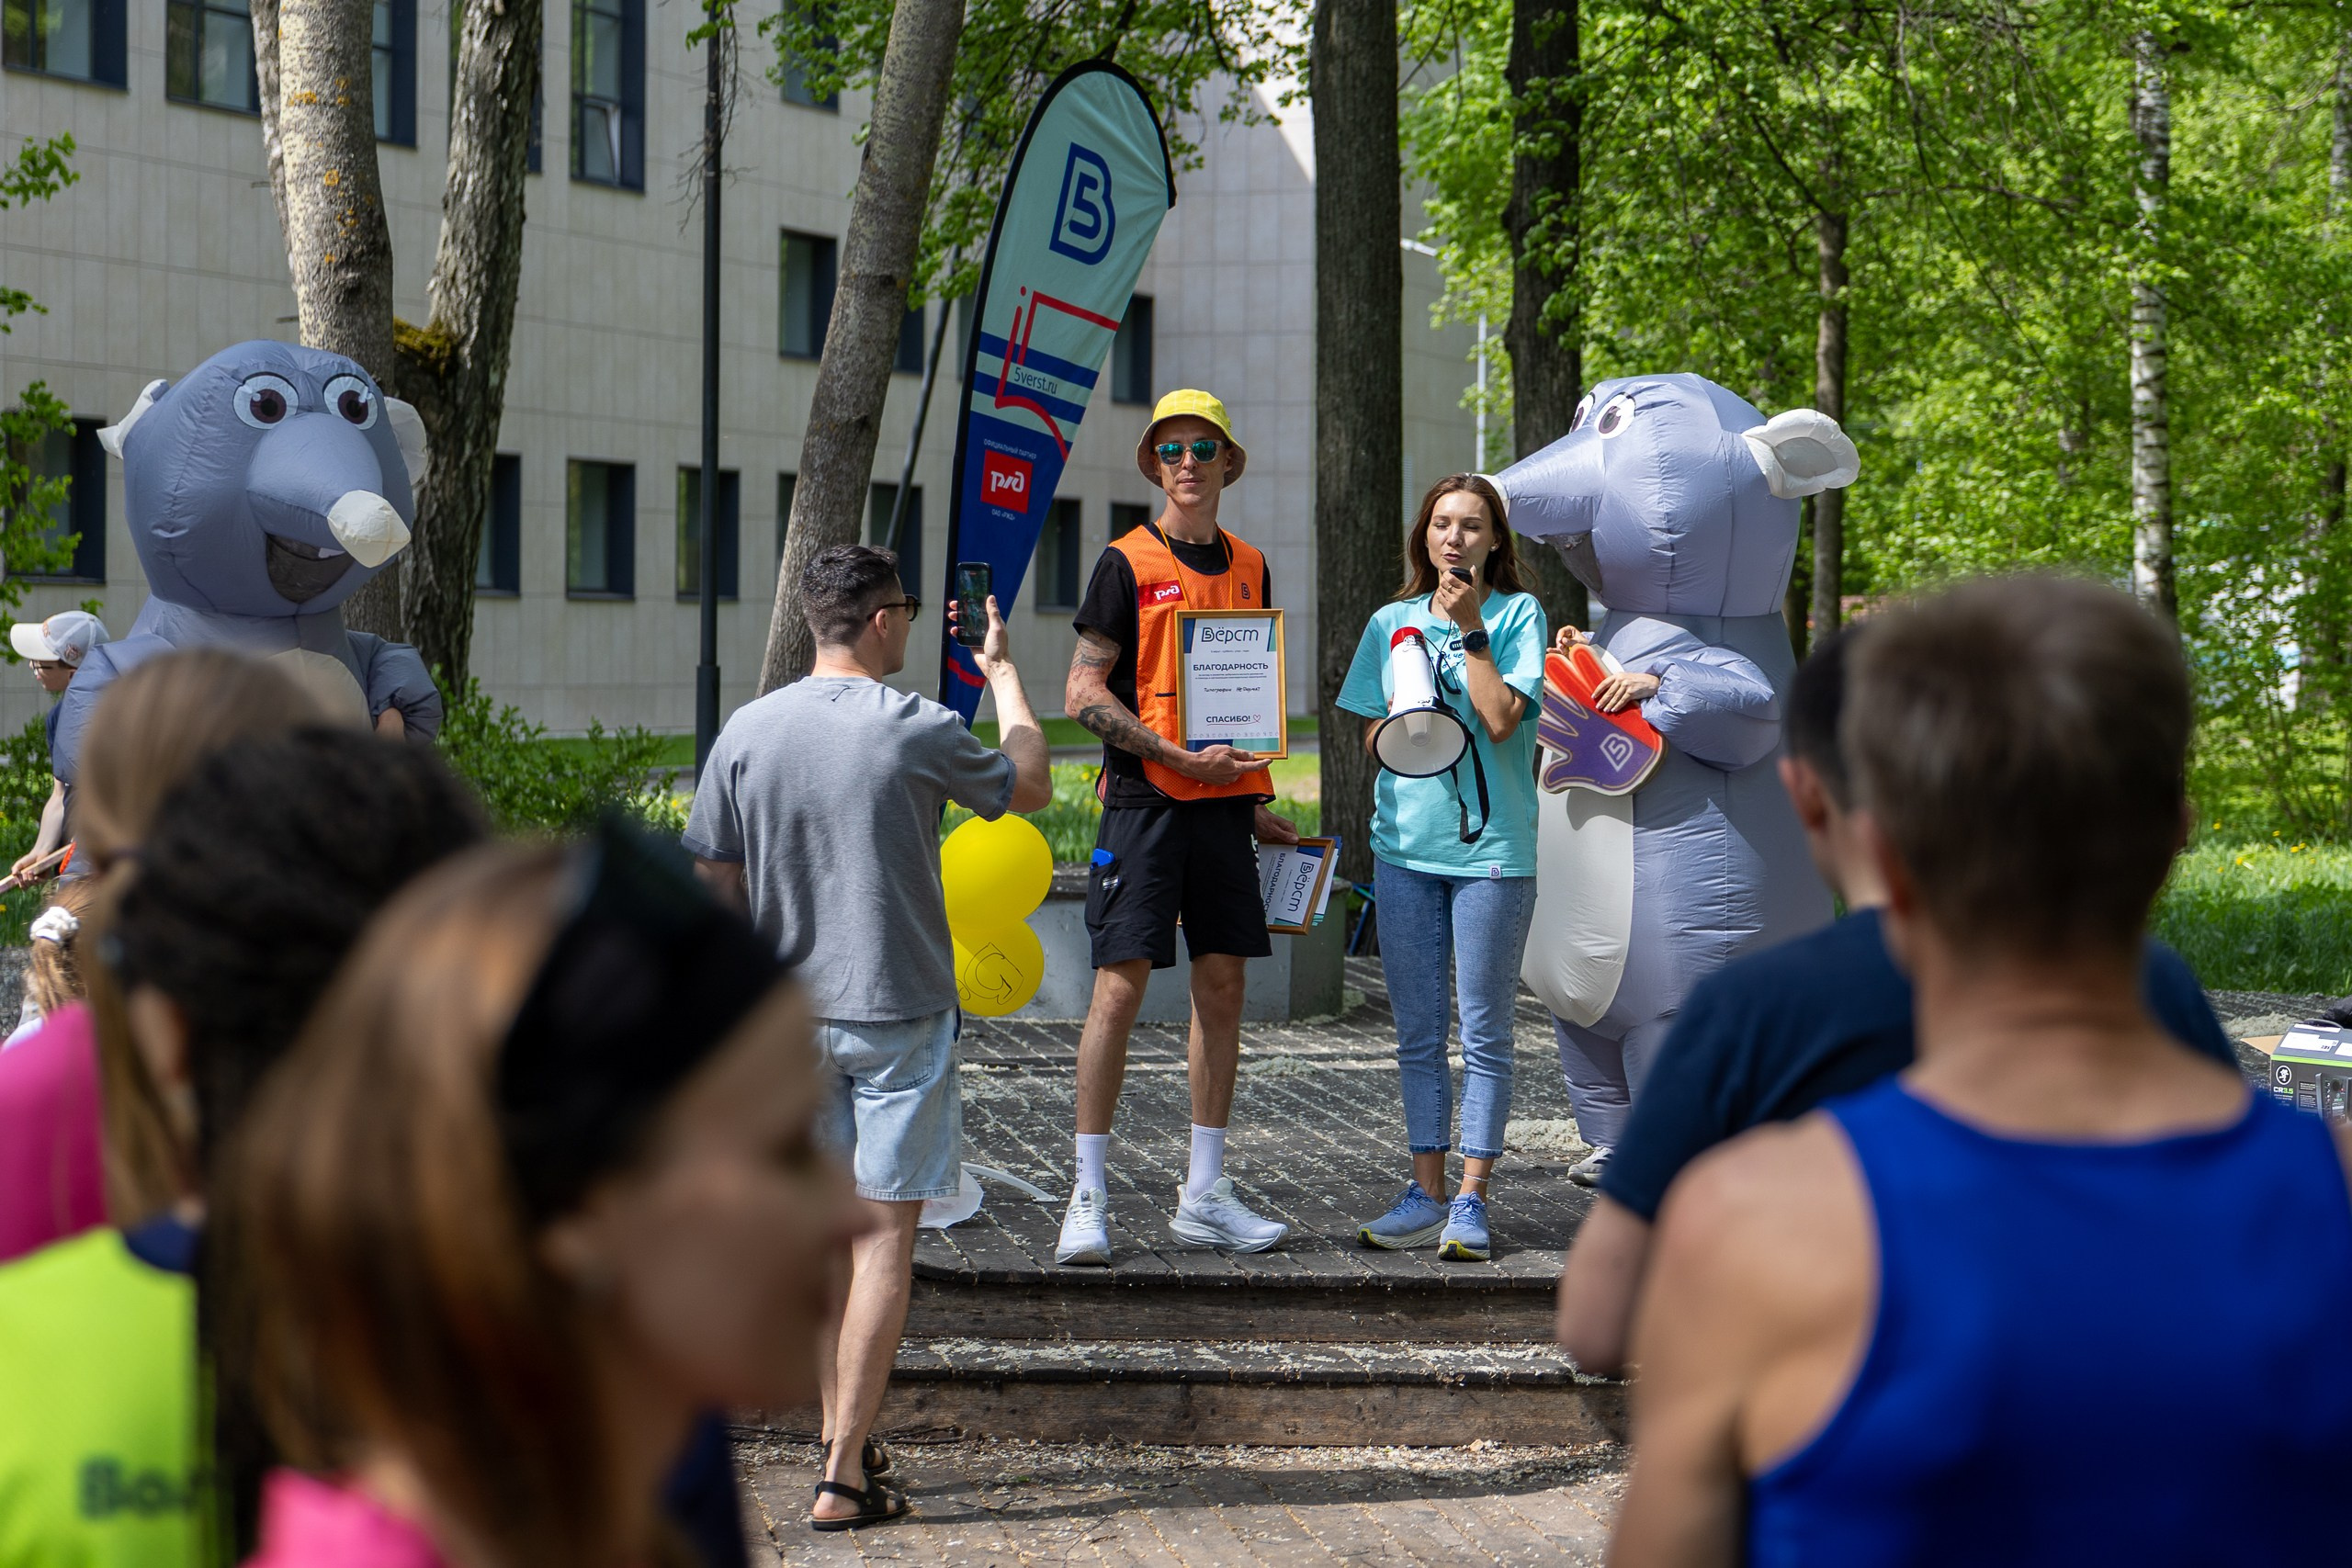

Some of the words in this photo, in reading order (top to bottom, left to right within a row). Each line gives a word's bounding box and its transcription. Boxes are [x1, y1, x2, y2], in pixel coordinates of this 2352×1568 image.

[1014, 367, 1057, 394] 5verst.ru
[983, 438, 1018, 455] ОФИЦИАЛЬНЫЙ
[1019, 448, 1037, 459] ПАРТНЕР
[1193, 662, 1269, 671] БЛАГОДАРНОСТЬ
[1205, 715, 1250, 724] СПАСИБО!
[2273, 1086, 2294, 1094] CR3.5
